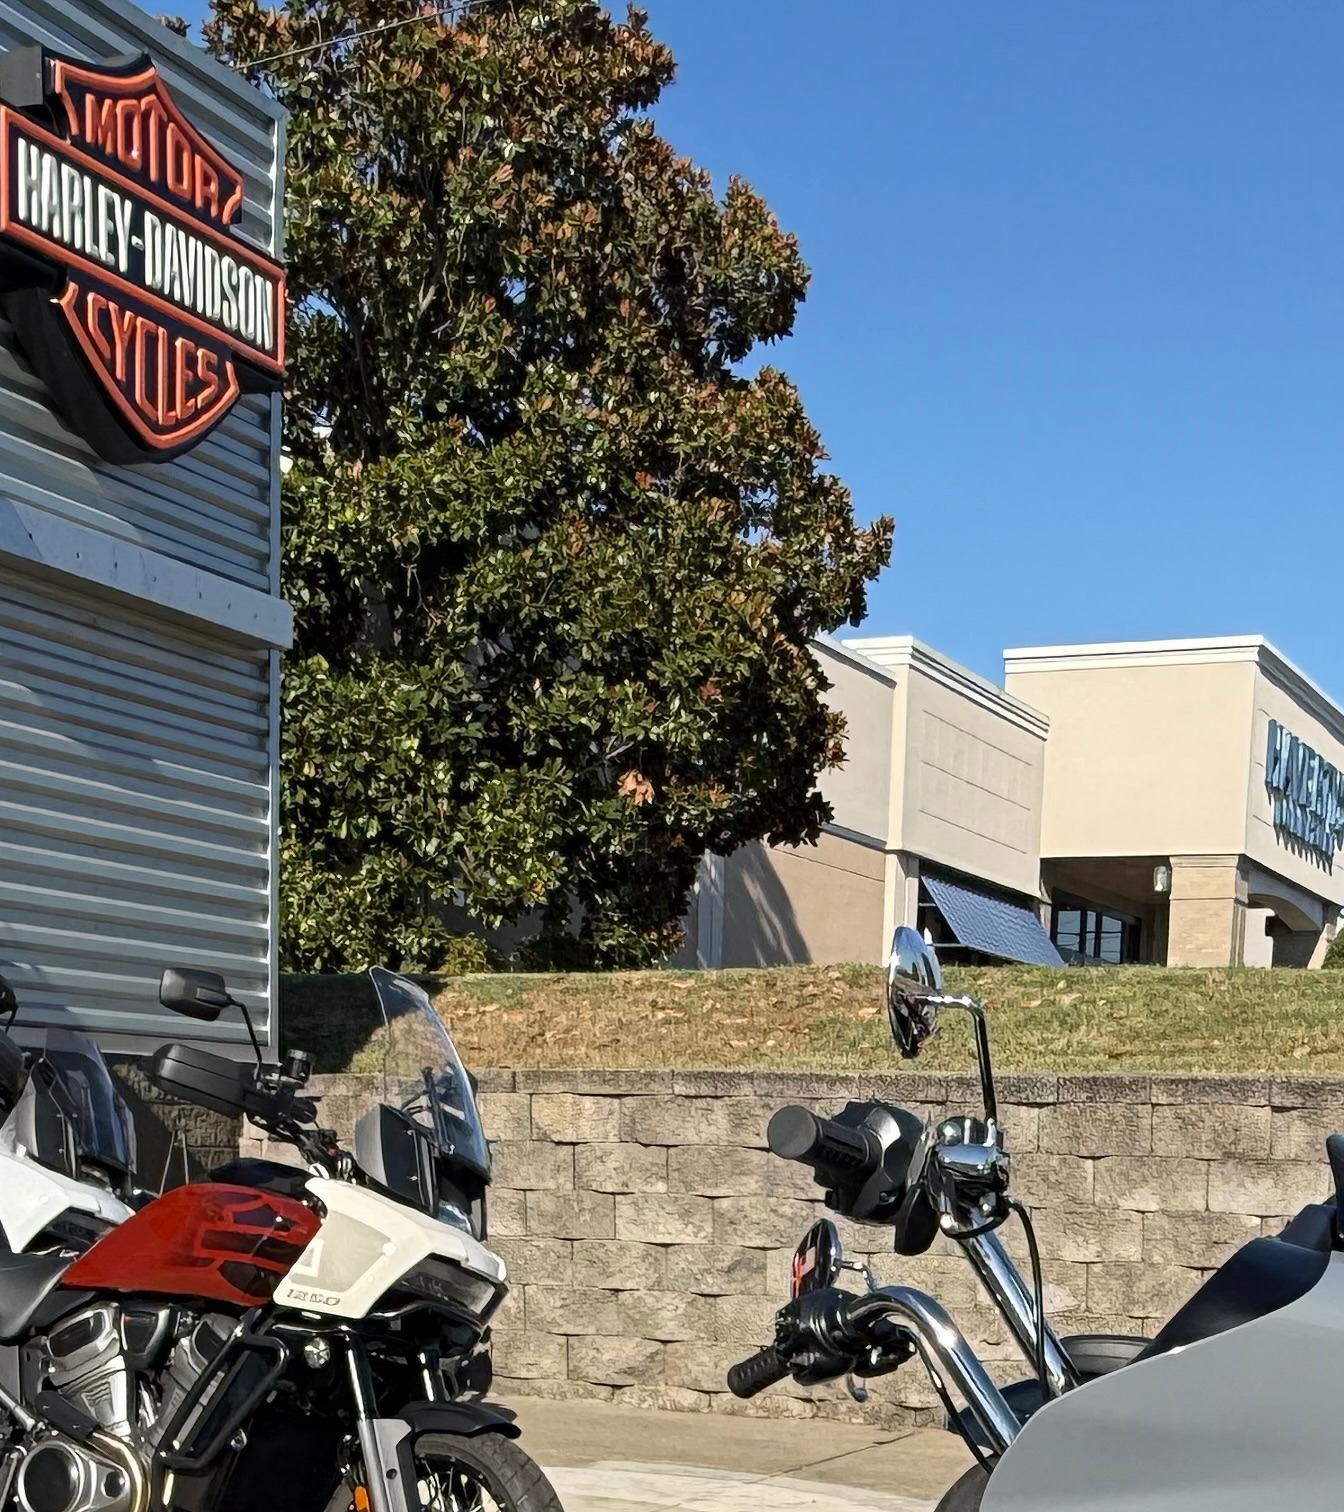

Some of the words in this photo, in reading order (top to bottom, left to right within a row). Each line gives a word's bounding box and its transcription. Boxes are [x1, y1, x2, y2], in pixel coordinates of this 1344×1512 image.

[85, 93, 220, 218] MOTOR
[17, 137, 274, 351] HARLEY-DAVIDSON
[87, 292, 219, 426] CYCLES
